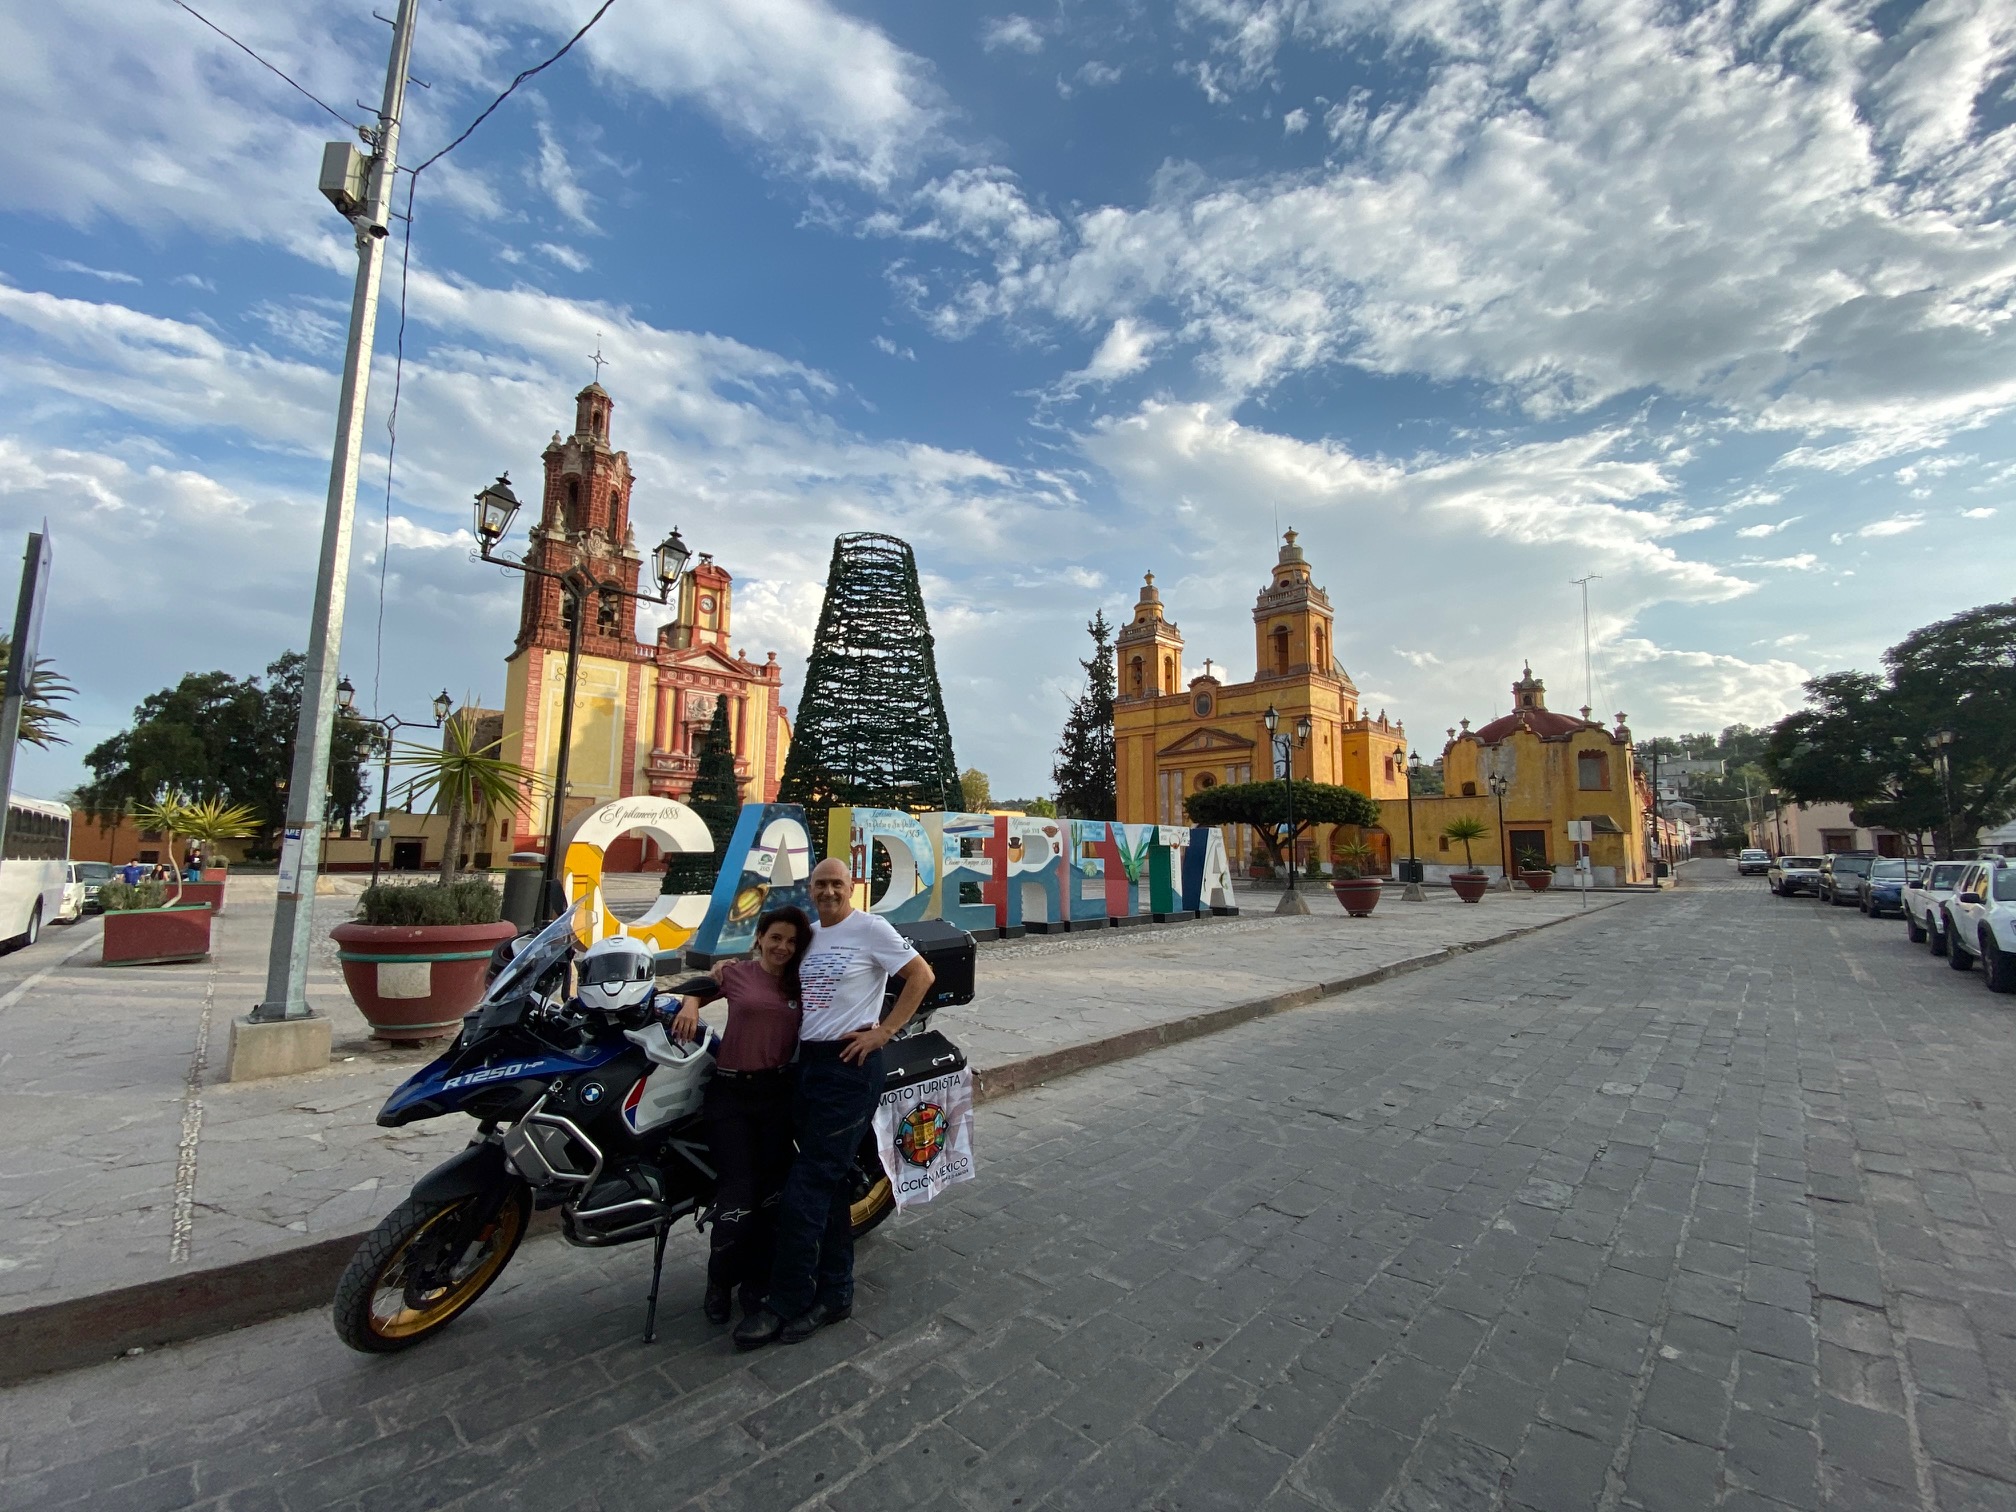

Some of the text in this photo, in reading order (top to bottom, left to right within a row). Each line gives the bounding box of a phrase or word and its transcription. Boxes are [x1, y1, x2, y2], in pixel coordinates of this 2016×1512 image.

[600, 804, 680, 827] El pilancón 1888
[562, 795, 1235, 956] CADEREYTA
[442, 1061, 545, 1090] R 1250 HP
[879, 1074, 960, 1107] MOTO TURISTA
